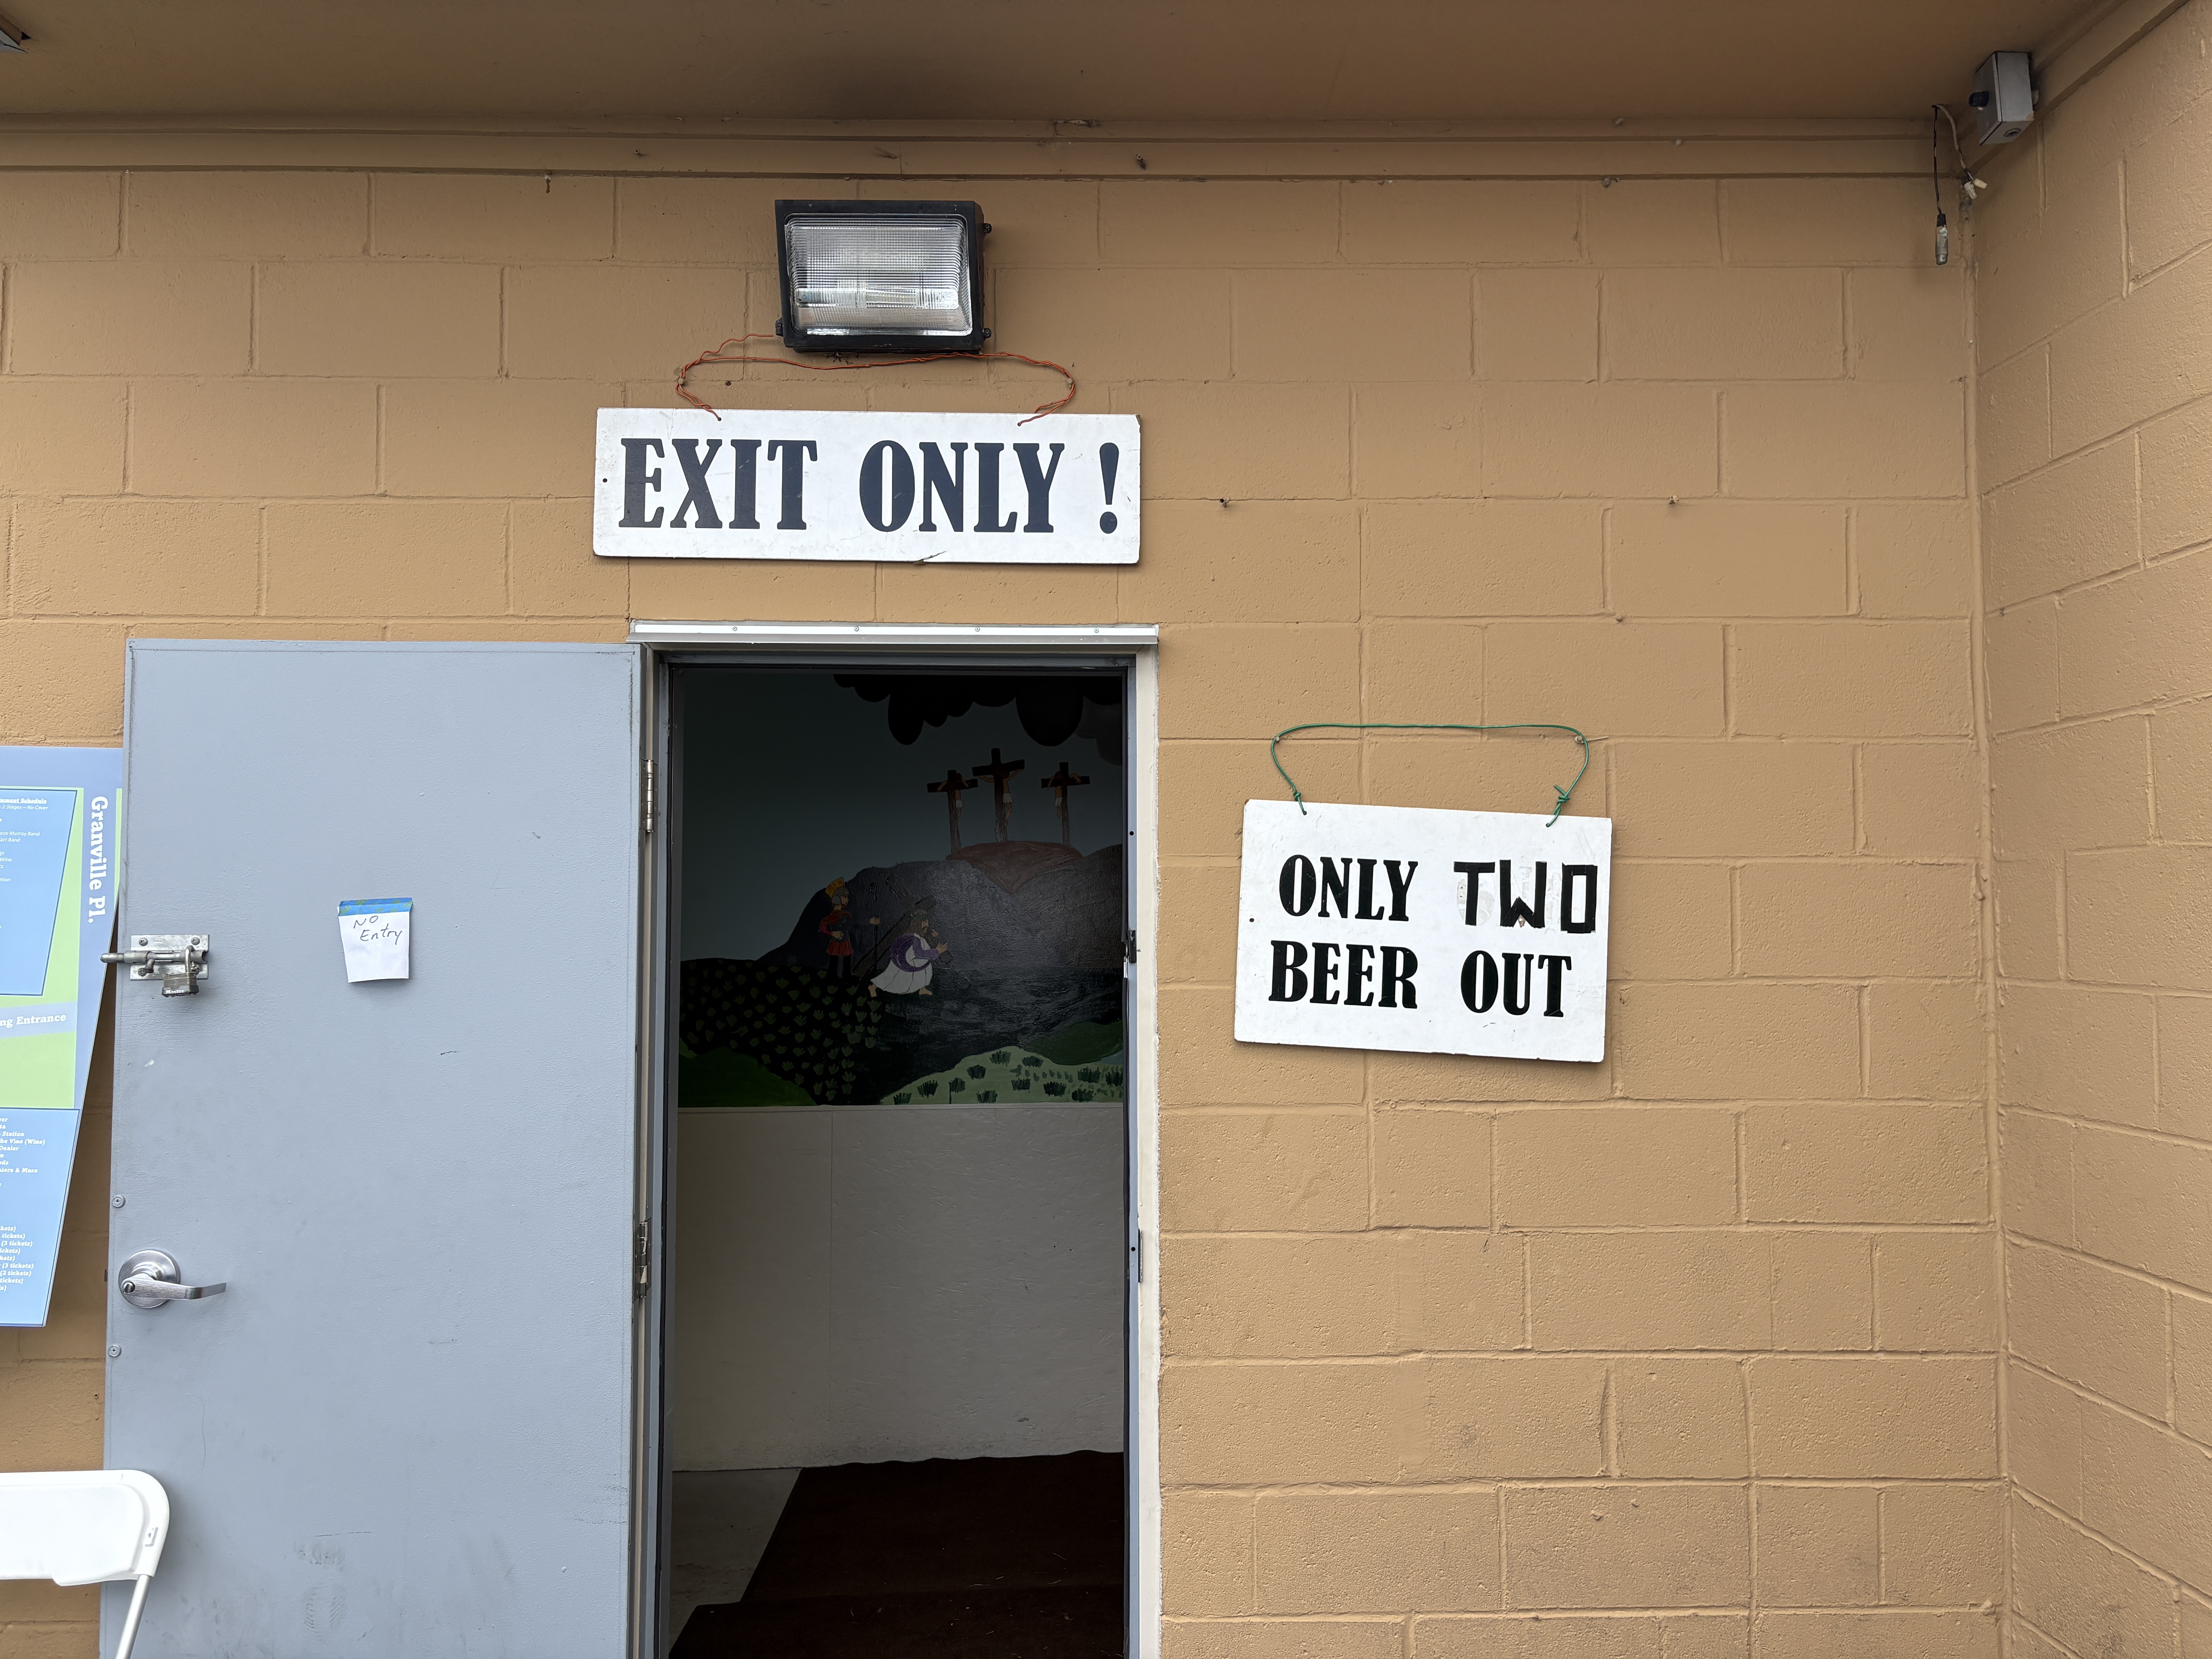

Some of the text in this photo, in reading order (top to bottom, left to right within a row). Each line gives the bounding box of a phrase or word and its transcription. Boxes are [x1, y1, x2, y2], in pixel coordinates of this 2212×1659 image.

[619, 438, 1119, 534] EXIT ONLY !
[88, 796, 108, 923] Granville Pl.
[1279, 855, 1598, 934] ONLY TWO
[360, 923, 402, 945] Entry
[1269, 940, 1572, 1017] BEER OUT
[16, 1014, 67, 1025] Entrance
